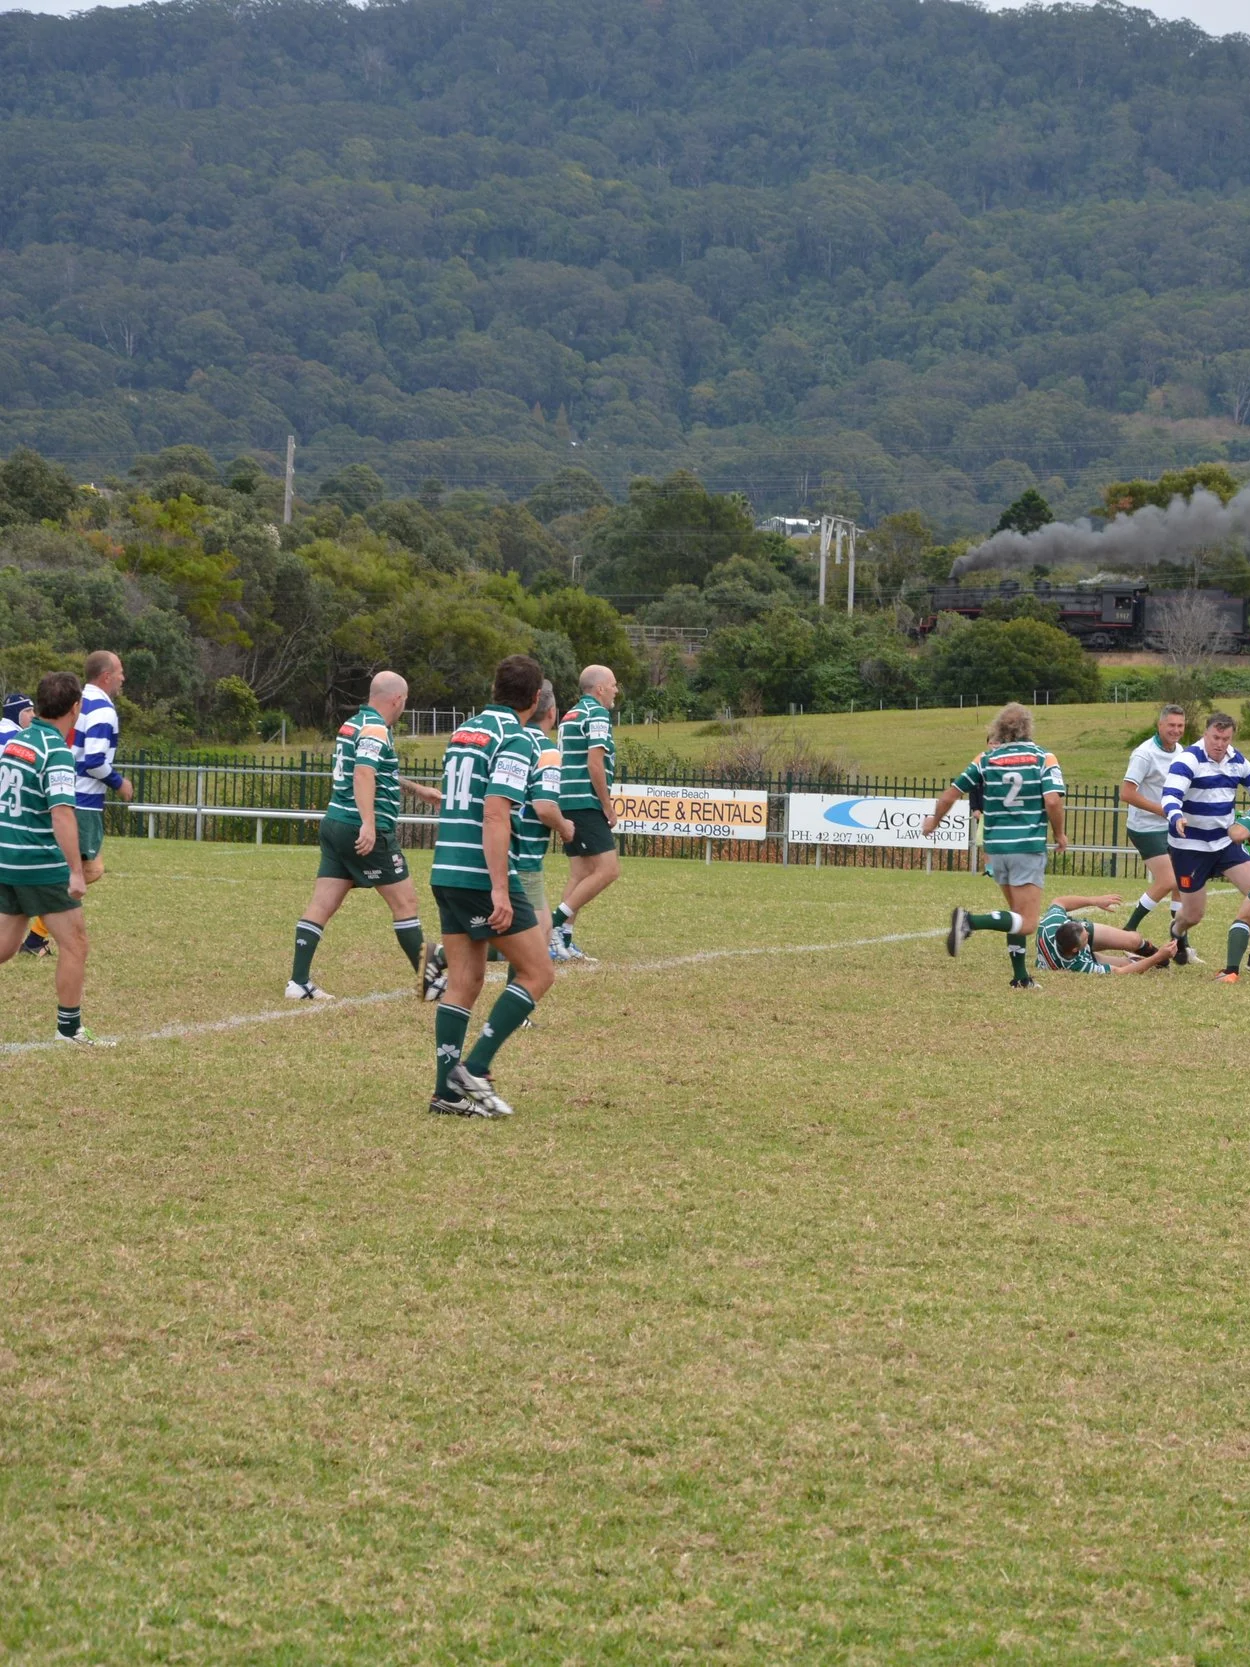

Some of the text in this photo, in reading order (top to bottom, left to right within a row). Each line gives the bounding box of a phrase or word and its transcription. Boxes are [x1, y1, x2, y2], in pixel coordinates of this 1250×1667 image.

[497, 760, 526, 776] Builders
[445, 756, 475, 810] 14
[1002, 771, 1024, 808] 2
[646, 787, 710, 800] Pioneer Beach
[609, 797, 763, 824] ORAGE & RENTALS
[875, 808, 966, 830] ACCSS
[791, 830, 874, 844] PH: 42 207 100
[896, 829, 921, 840] LAW
